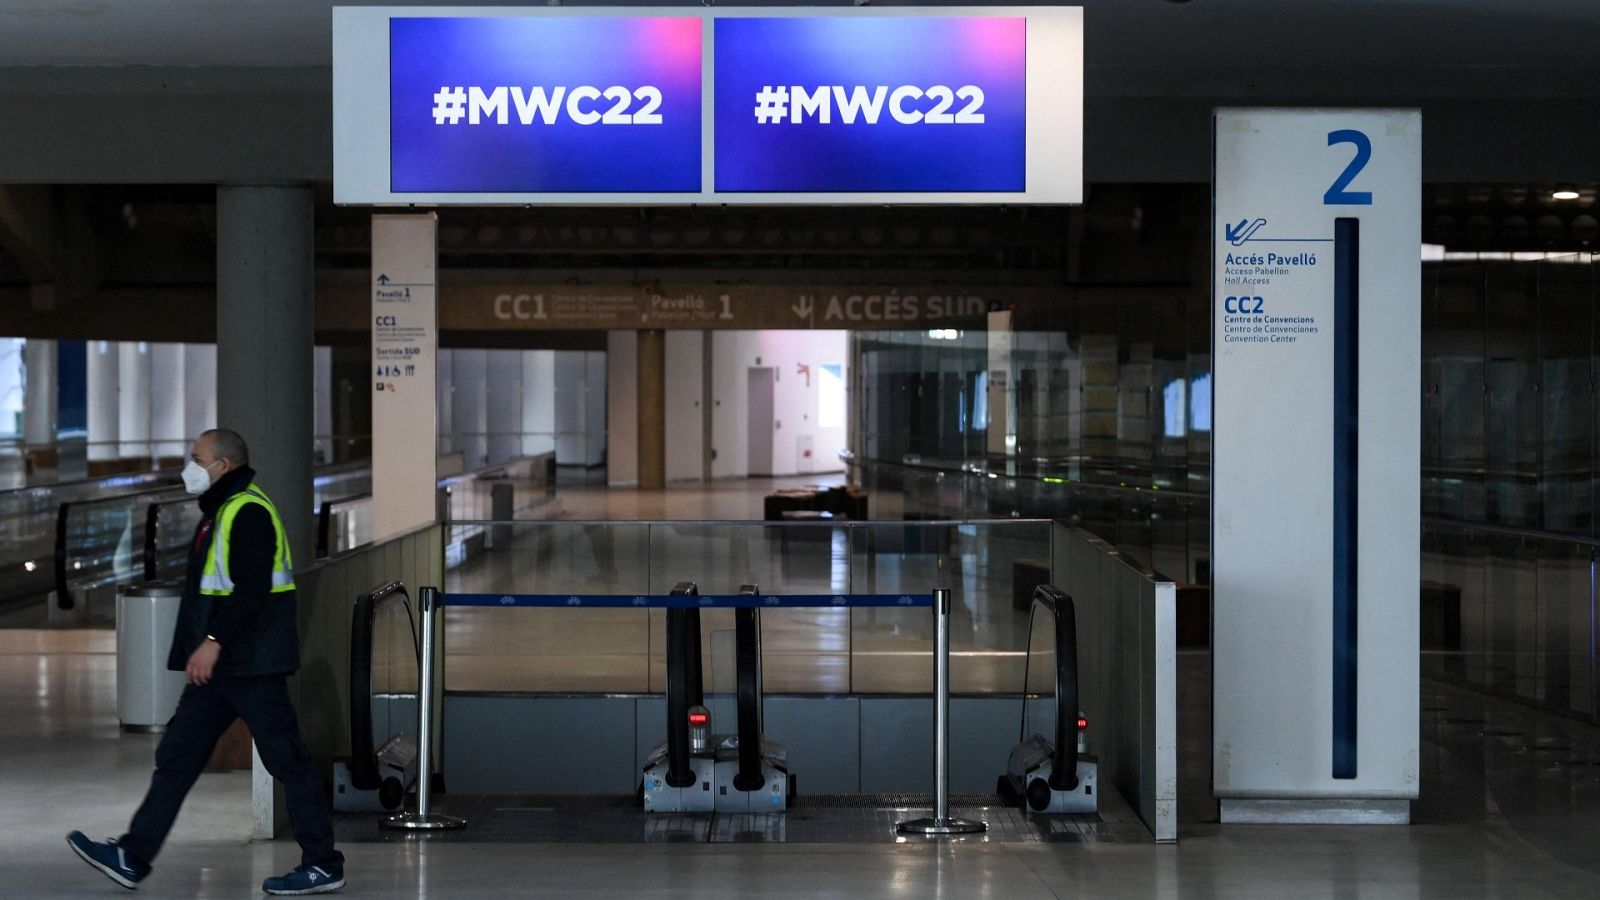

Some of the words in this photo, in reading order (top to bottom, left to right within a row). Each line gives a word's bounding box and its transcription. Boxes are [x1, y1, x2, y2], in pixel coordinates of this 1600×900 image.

[432, 85, 663, 126] #MWC22
[754, 84, 986, 125] #MWC22
[1323, 129, 1373, 205] 2
[1225, 252, 1264, 265] Accés
[1267, 252, 1316, 265] Pavelló
[1225, 267, 1253, 275] Acceso
[1242, 276, 1270, 285] Access
[493, 294, 548, 320] CC1
[719, 294, 734, 319] 1
[825, 288, 919, 321] ACCÉS
[1224, 296, 1264, 314] CC2
[375, 315, 396, 326] CC1
[1224, 315, 1251, 324] Centre
[1252, 315, 1262, 324] de
[1264, 315, 1314, 324] Convencions
[1224, 325, 1251, 333] Centro
[1252, 325, 1262, 333] de
[1264, 325, 1318, 333] Convenciones
[1224, 334, 1268, 343] Convention
[1270, 334, 1296, 343] Center
